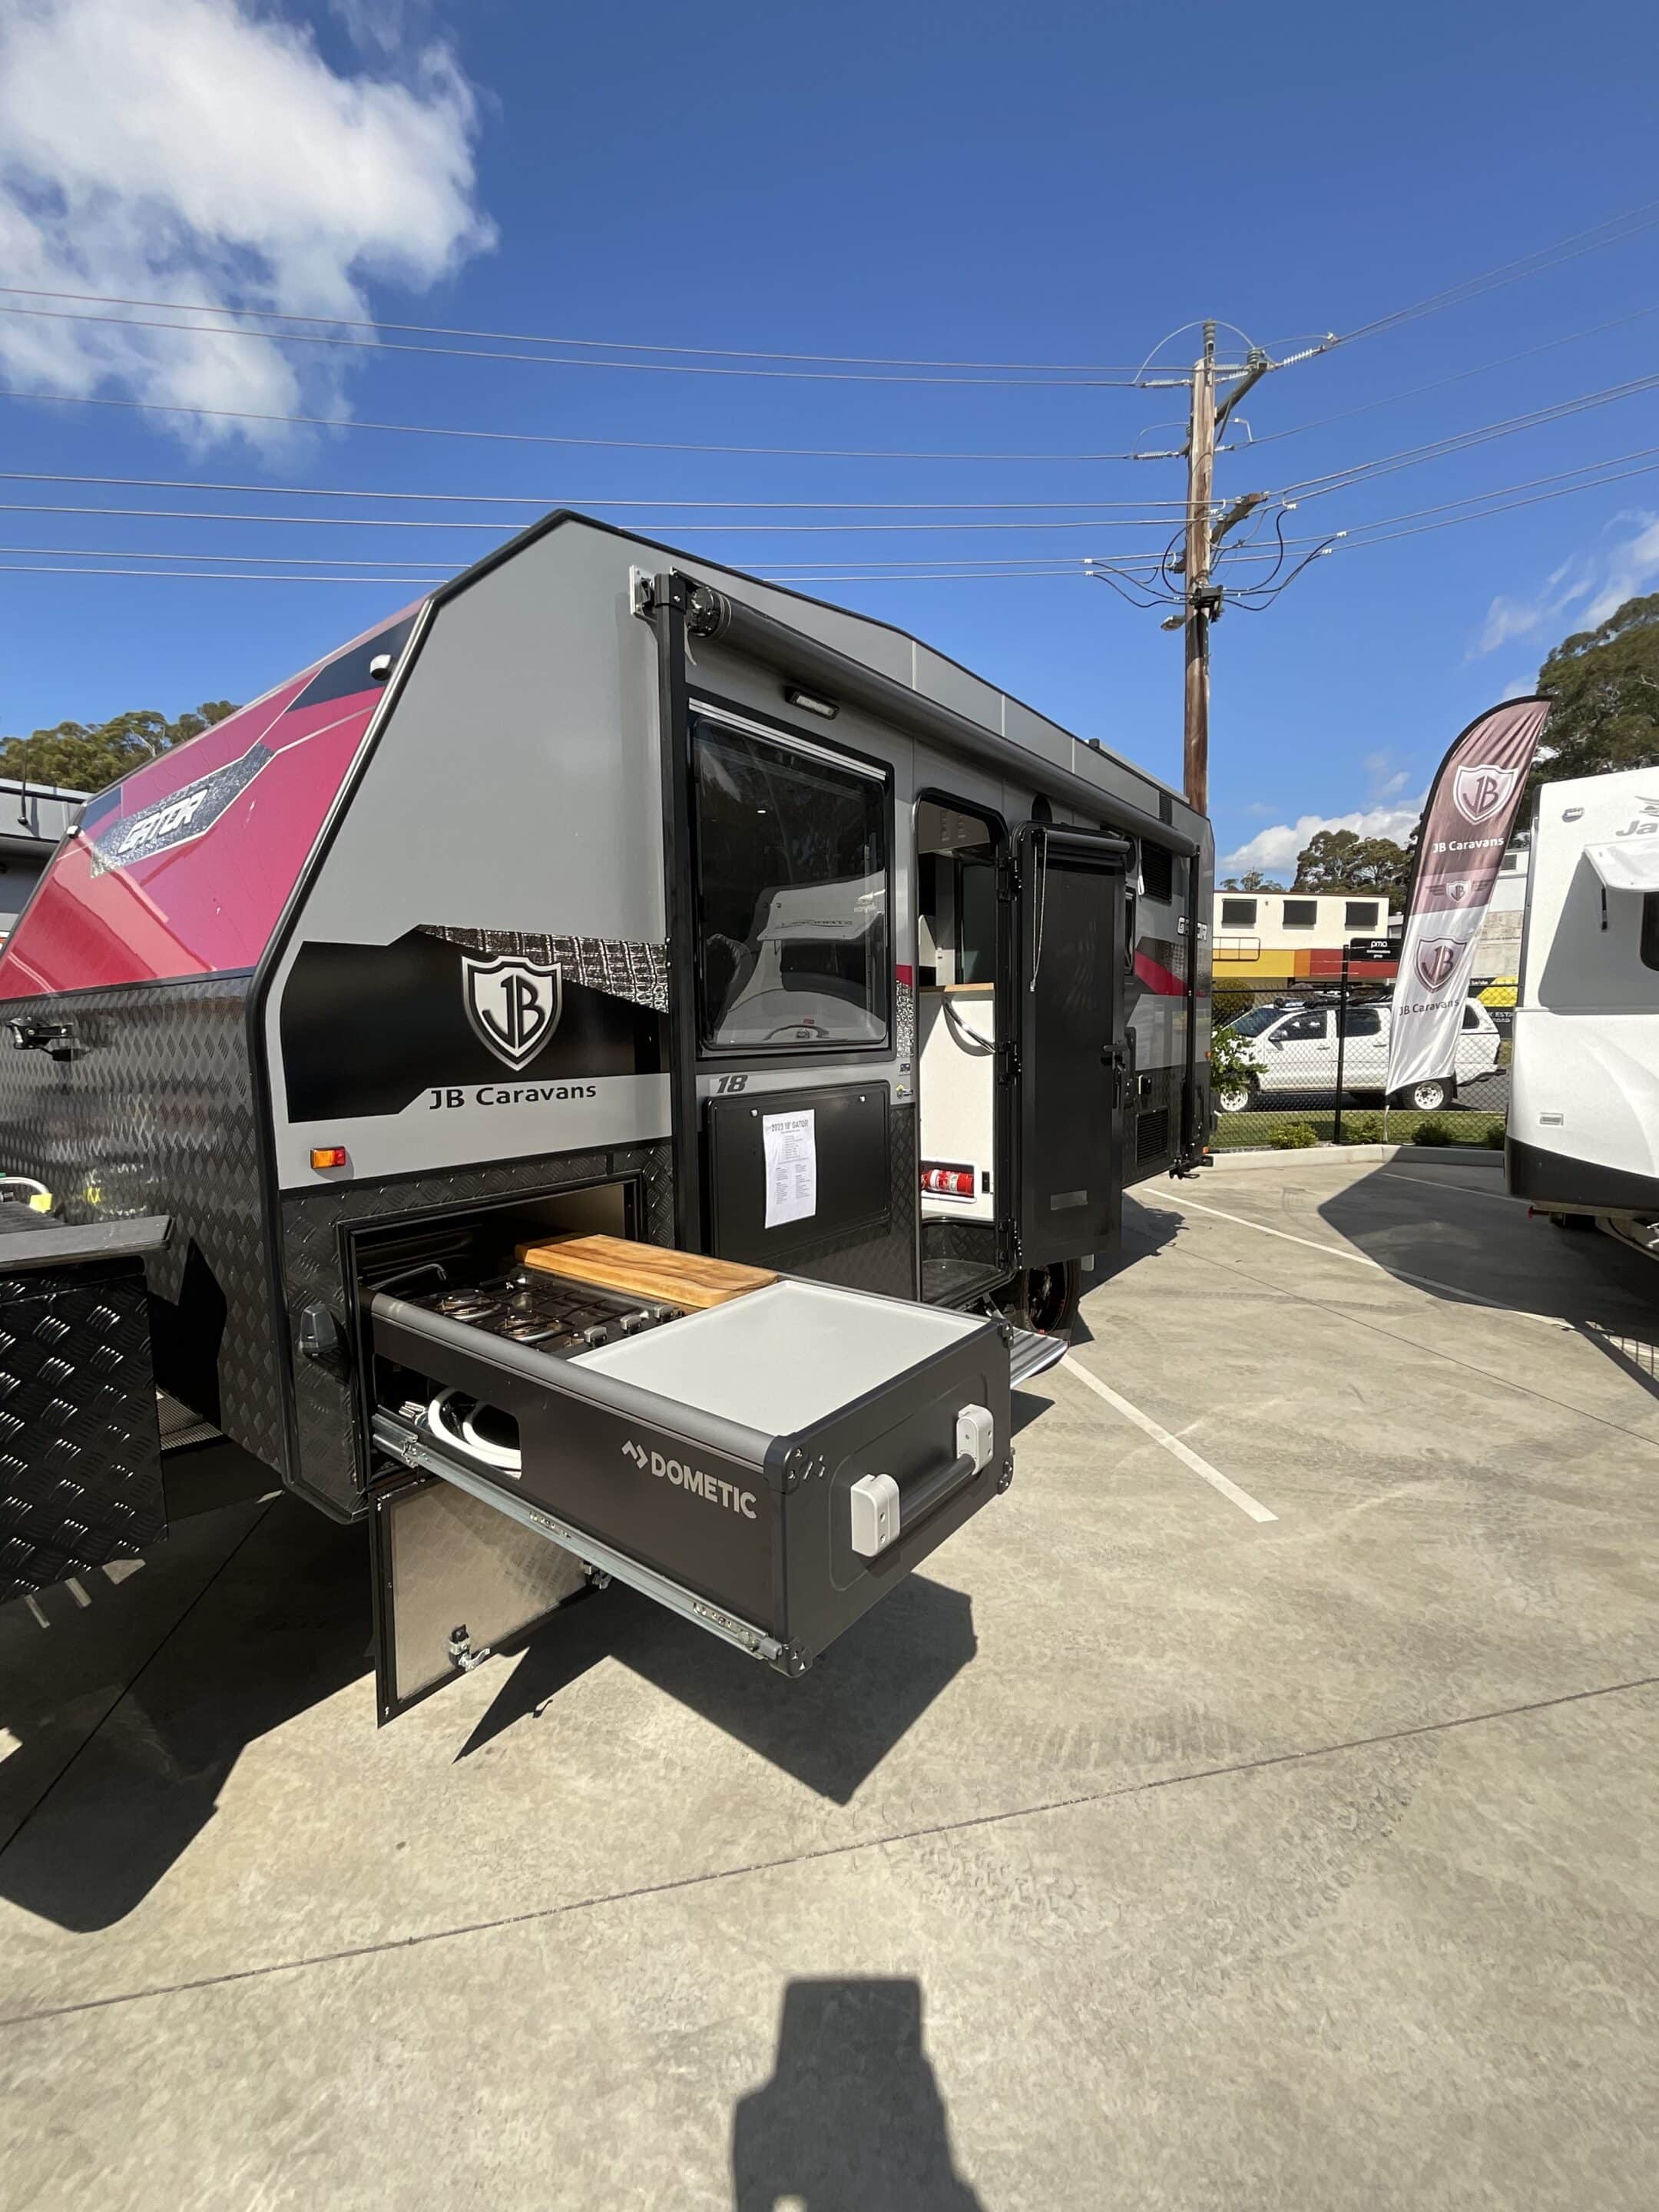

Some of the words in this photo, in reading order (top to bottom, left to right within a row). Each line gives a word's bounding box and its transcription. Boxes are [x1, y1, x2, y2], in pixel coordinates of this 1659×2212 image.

[1462, 775, 1499, 815] JB
[118, 788, 210, 854] GATOR
[1615, 820, 1659, 836] Ja
[1433, 842, 1446, 854] JB
[1449, 837, 1505, 852] Caravans
[1422, 945, 1454, 985] JB
[482, 974, 545, 1050] JB
[1399, 1005, 1410, 1016] JB
[1412, 998, 1460, 1013] Caravans
[717, 1075, 748, 1094] 18
[429, 1088, 465, 1110] JB
[476, 1085, 597, 1106] Caravans
[771, 1123, 784, 1132] 2023
[792, 1119, 809, 1129] GATOR
[651, 1451, 757, 1519] DOMETIC
